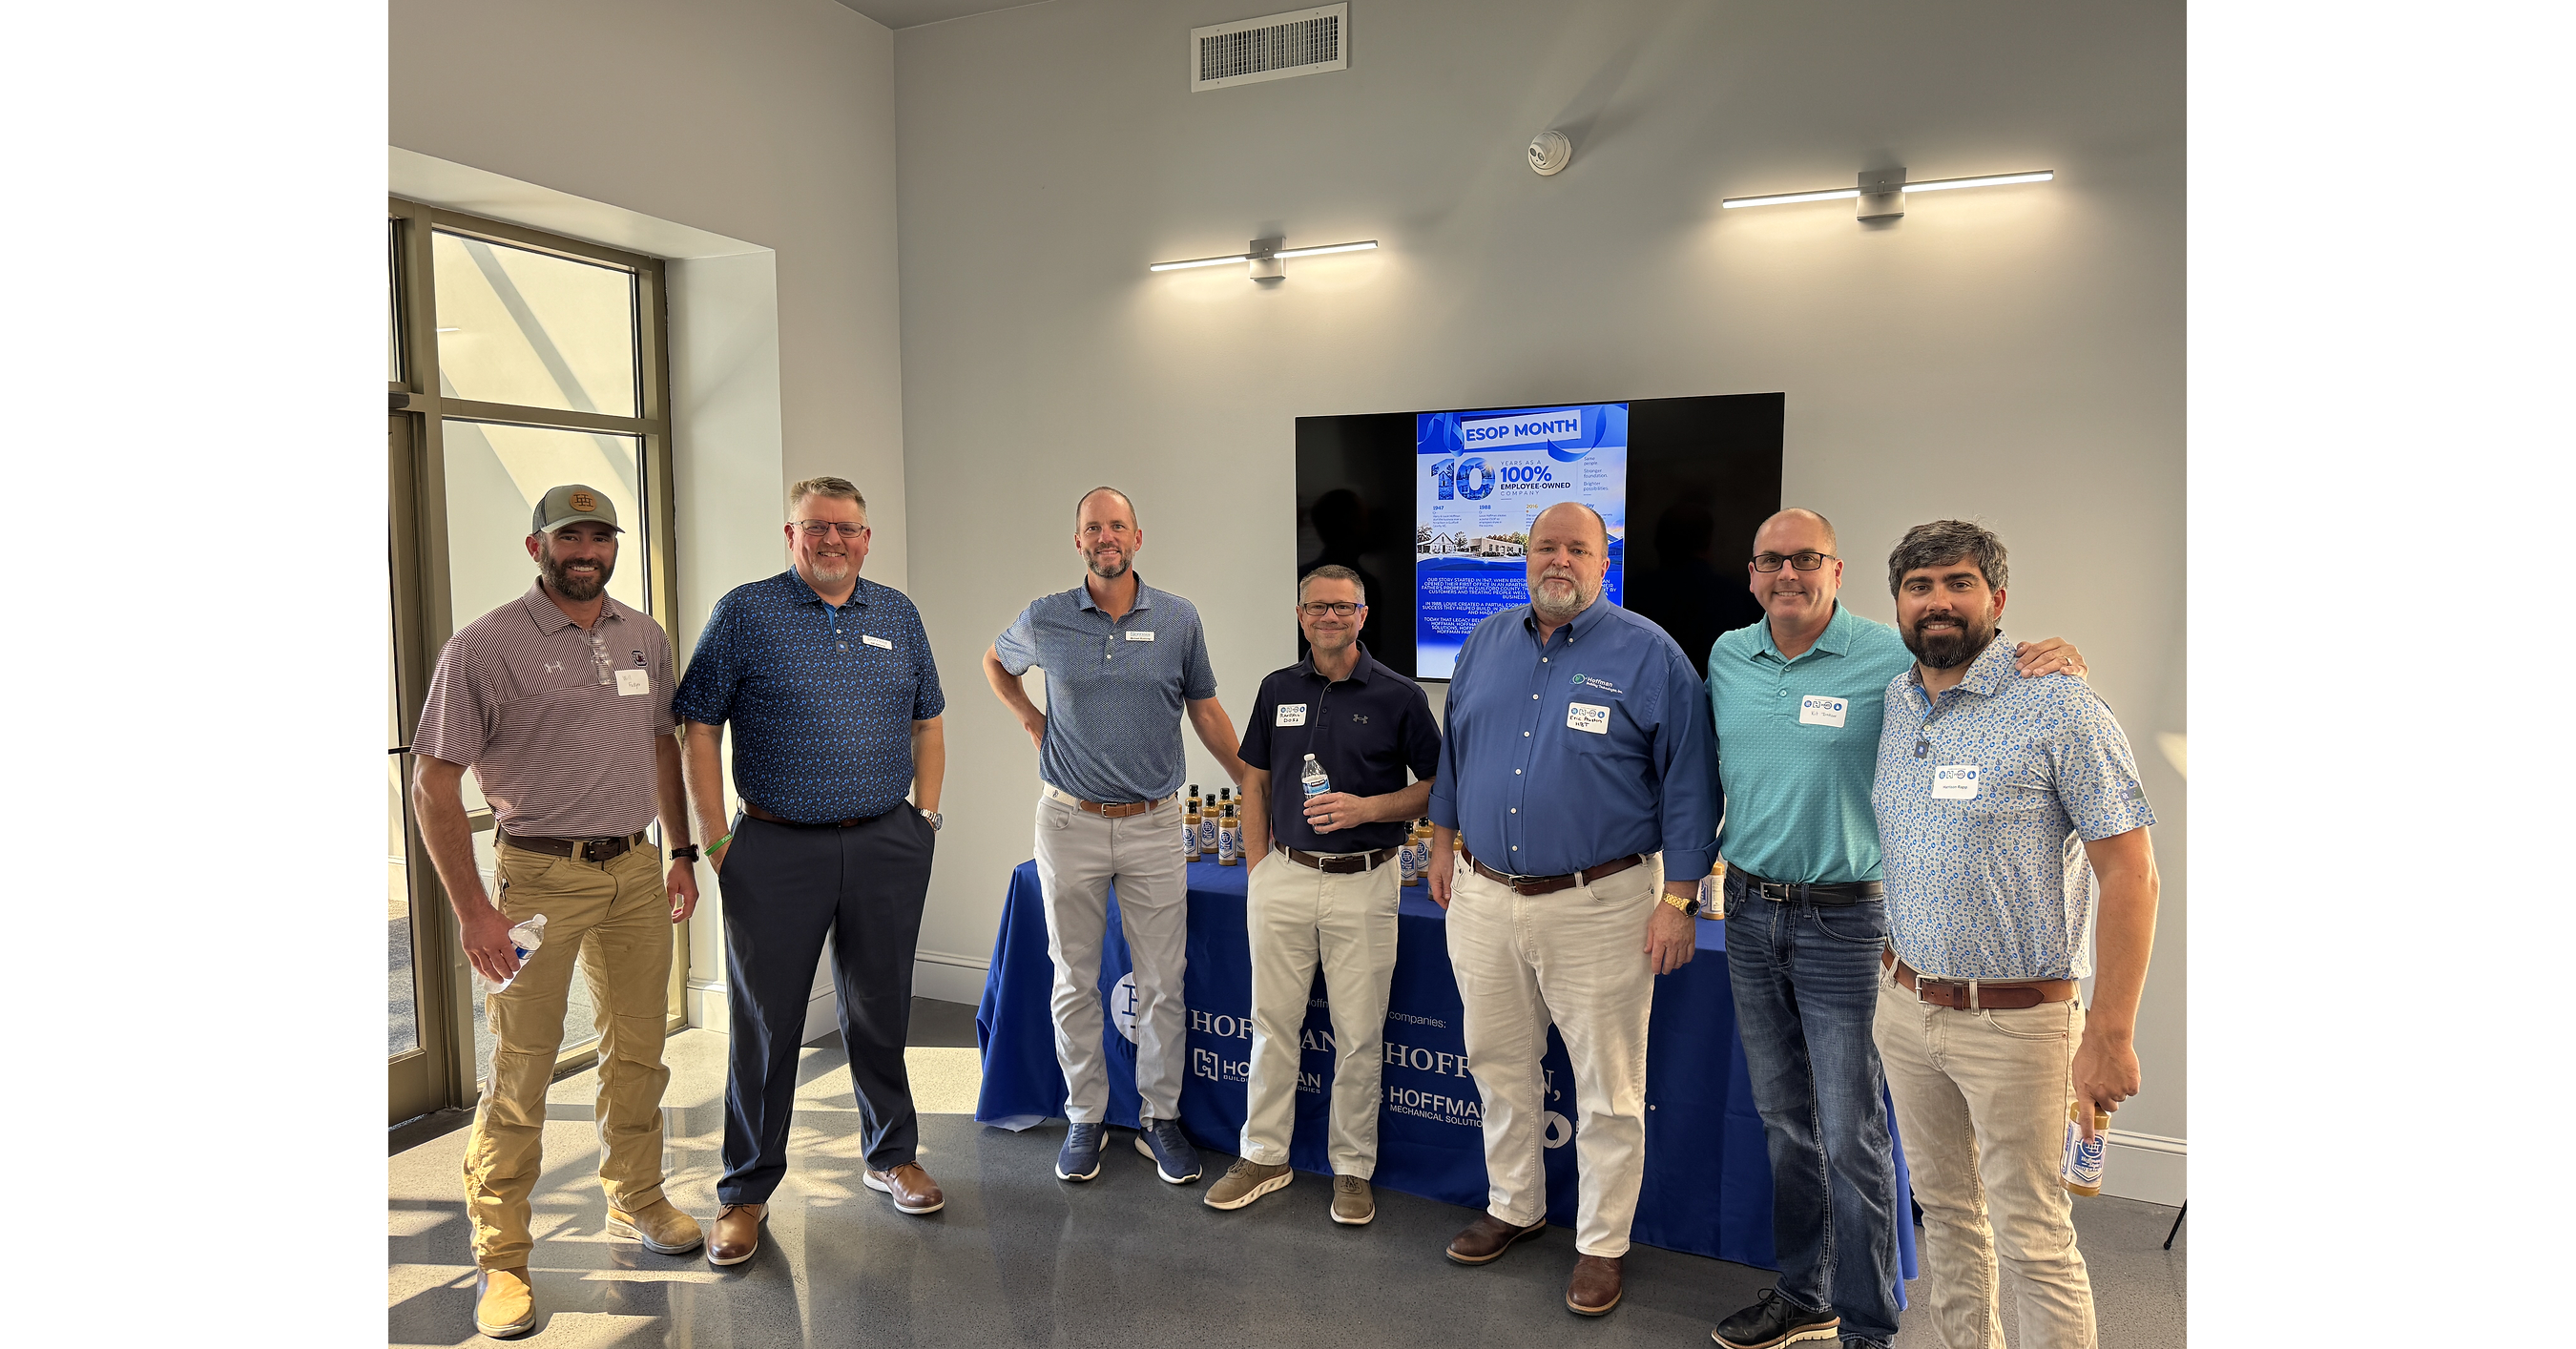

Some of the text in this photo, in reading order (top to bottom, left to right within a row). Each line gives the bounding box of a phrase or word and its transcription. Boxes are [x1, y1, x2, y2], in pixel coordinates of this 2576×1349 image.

[1465, 419, 1578, 442] ESOP MONTH
[1431, 457, 1496, 501] 10
[1501, 466, 1552, 483] 100%
[1587, 676, 1613, 688] Hoffman
[1388, 1011, 1446, 1028] companies:
[1389, 1104, 1484, 1128] MECHANICAL SOLUTIO
